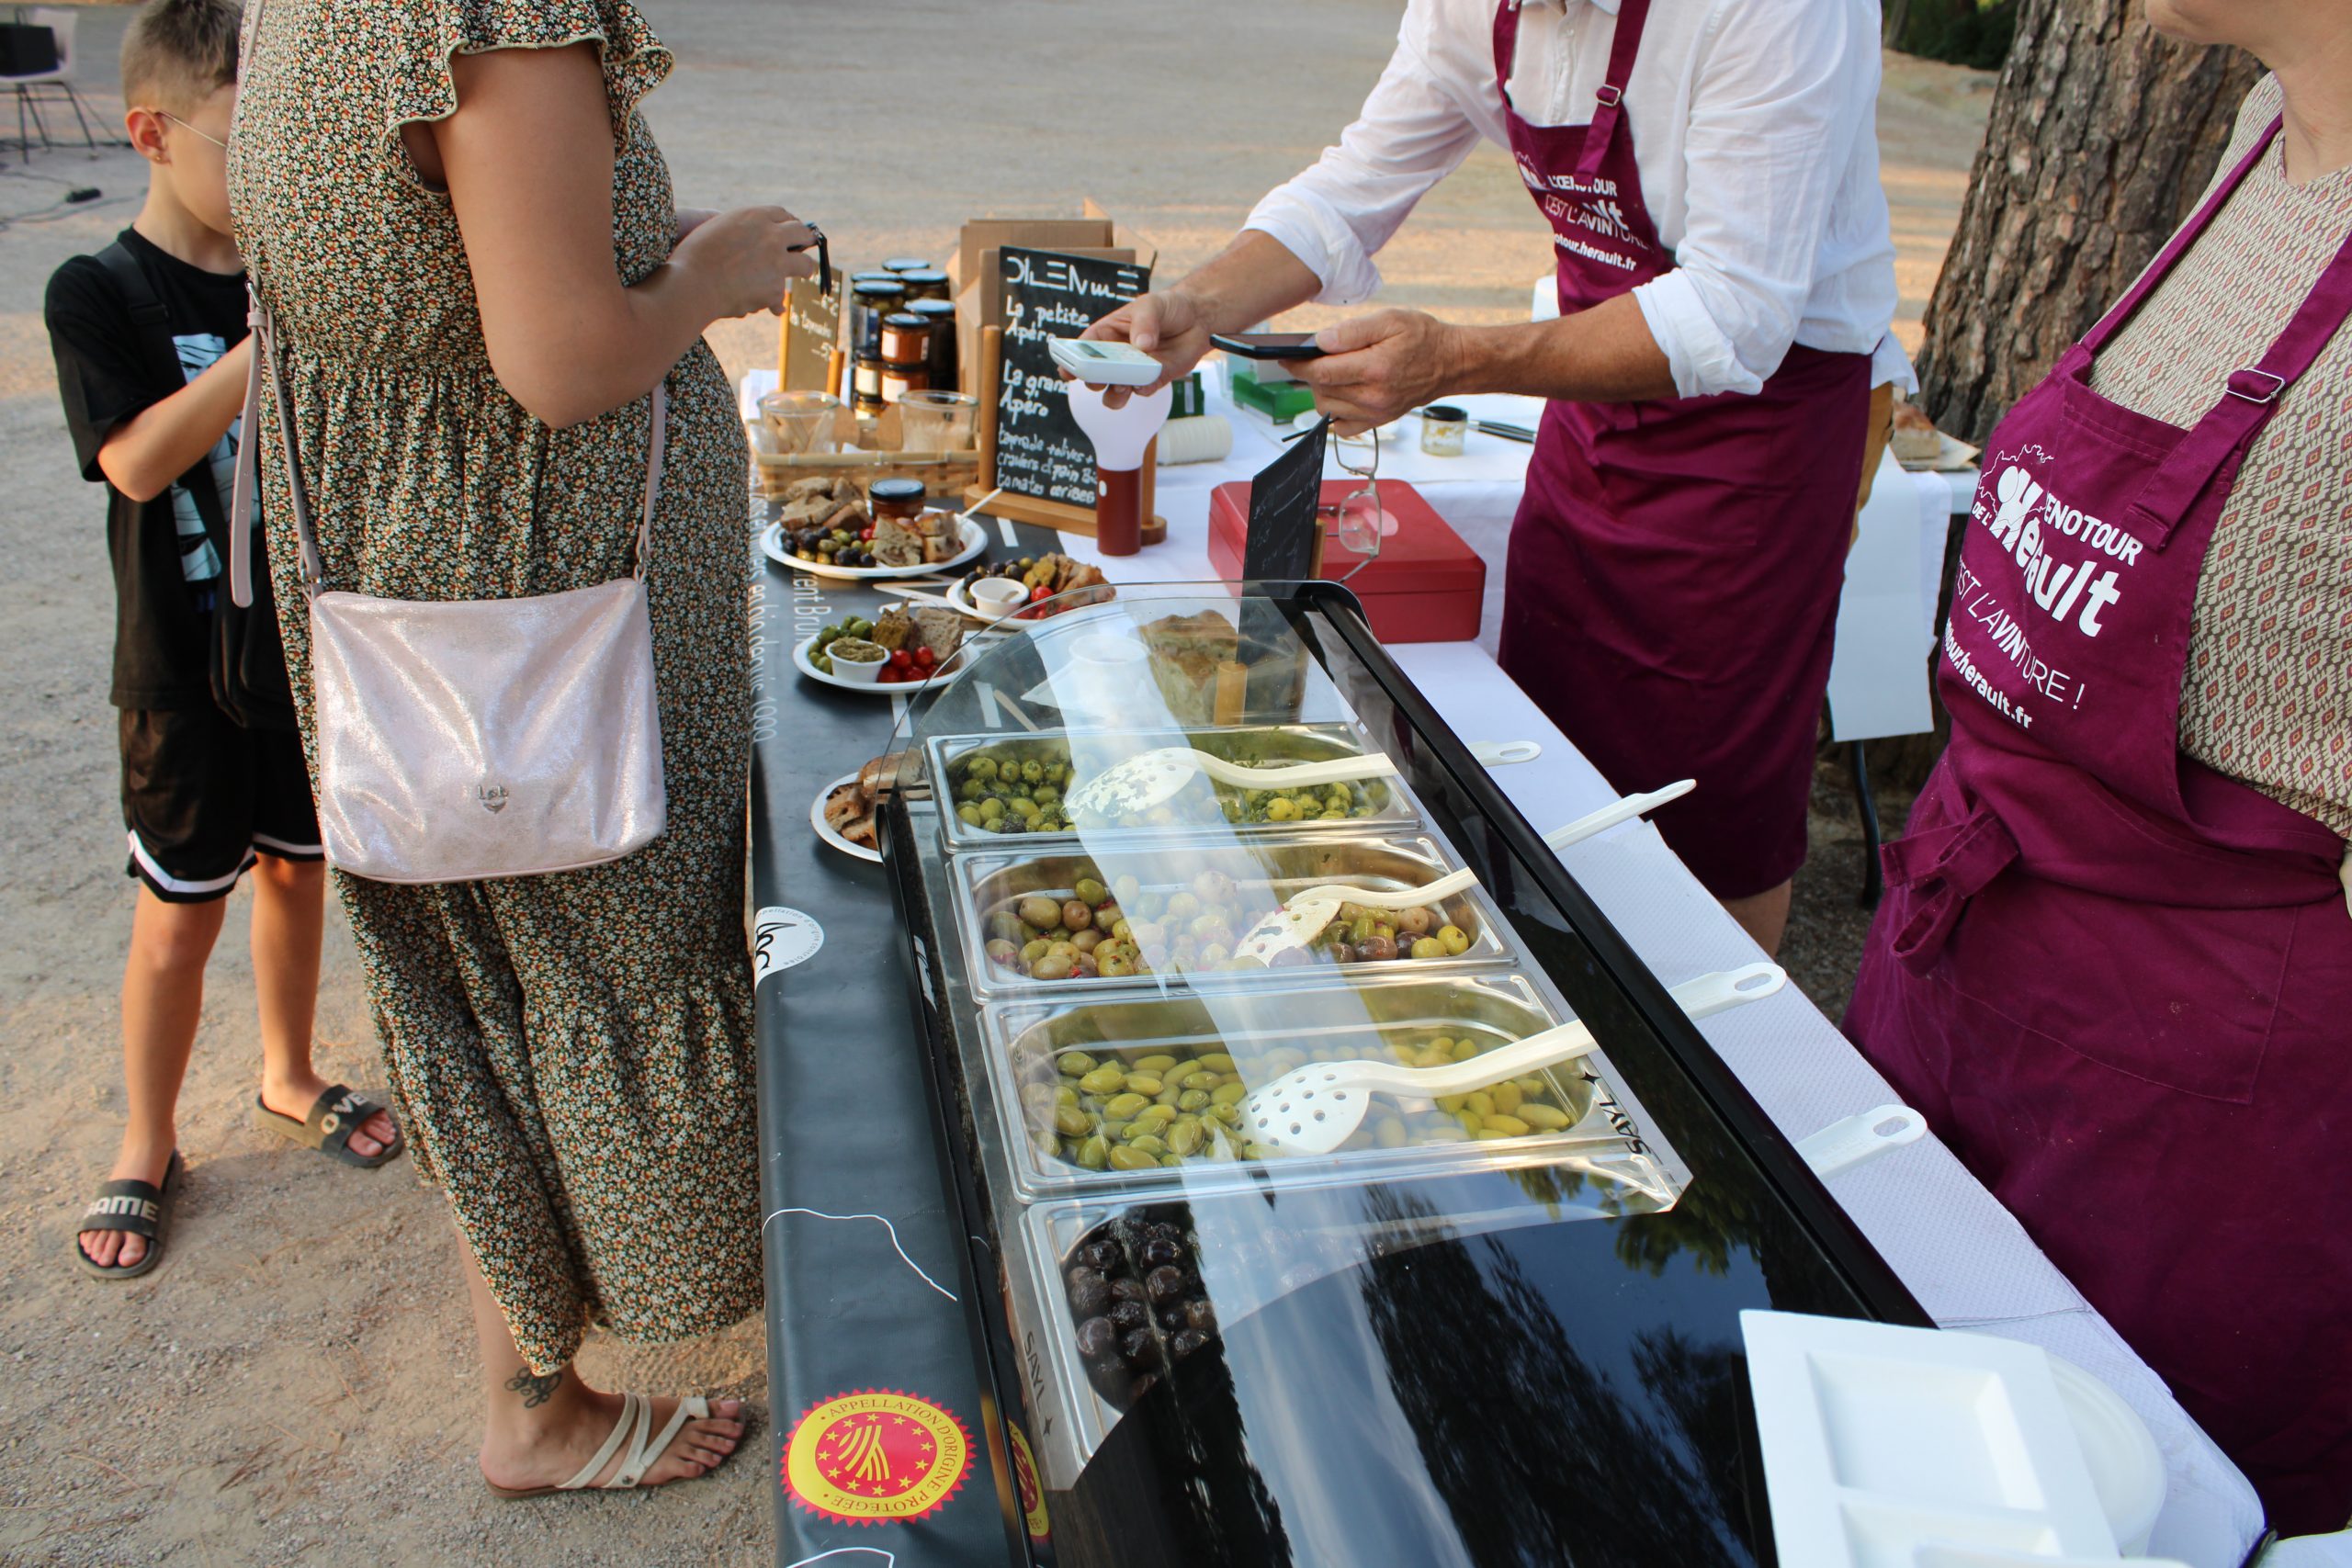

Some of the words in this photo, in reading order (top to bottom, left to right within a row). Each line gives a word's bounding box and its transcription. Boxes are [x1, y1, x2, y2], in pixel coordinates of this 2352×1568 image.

[1554, 232, 1637, 271] otour.herault.fr
[1005, 294, 1024, 319] La
[1035, 301, 1091, 328] petite
[1003, 359, 1023, 386] La
[1972, 501, 1985, 521] DE
[793, 570, 820, 603] rent
[2072, 682, 2086, 710] !
[829, 1398, 943, 1426] APPELLATION
[927, 1424, 958, 1493] D'ORIGINE
[831, 1491, 931, 1516] PROTÉGÉE
